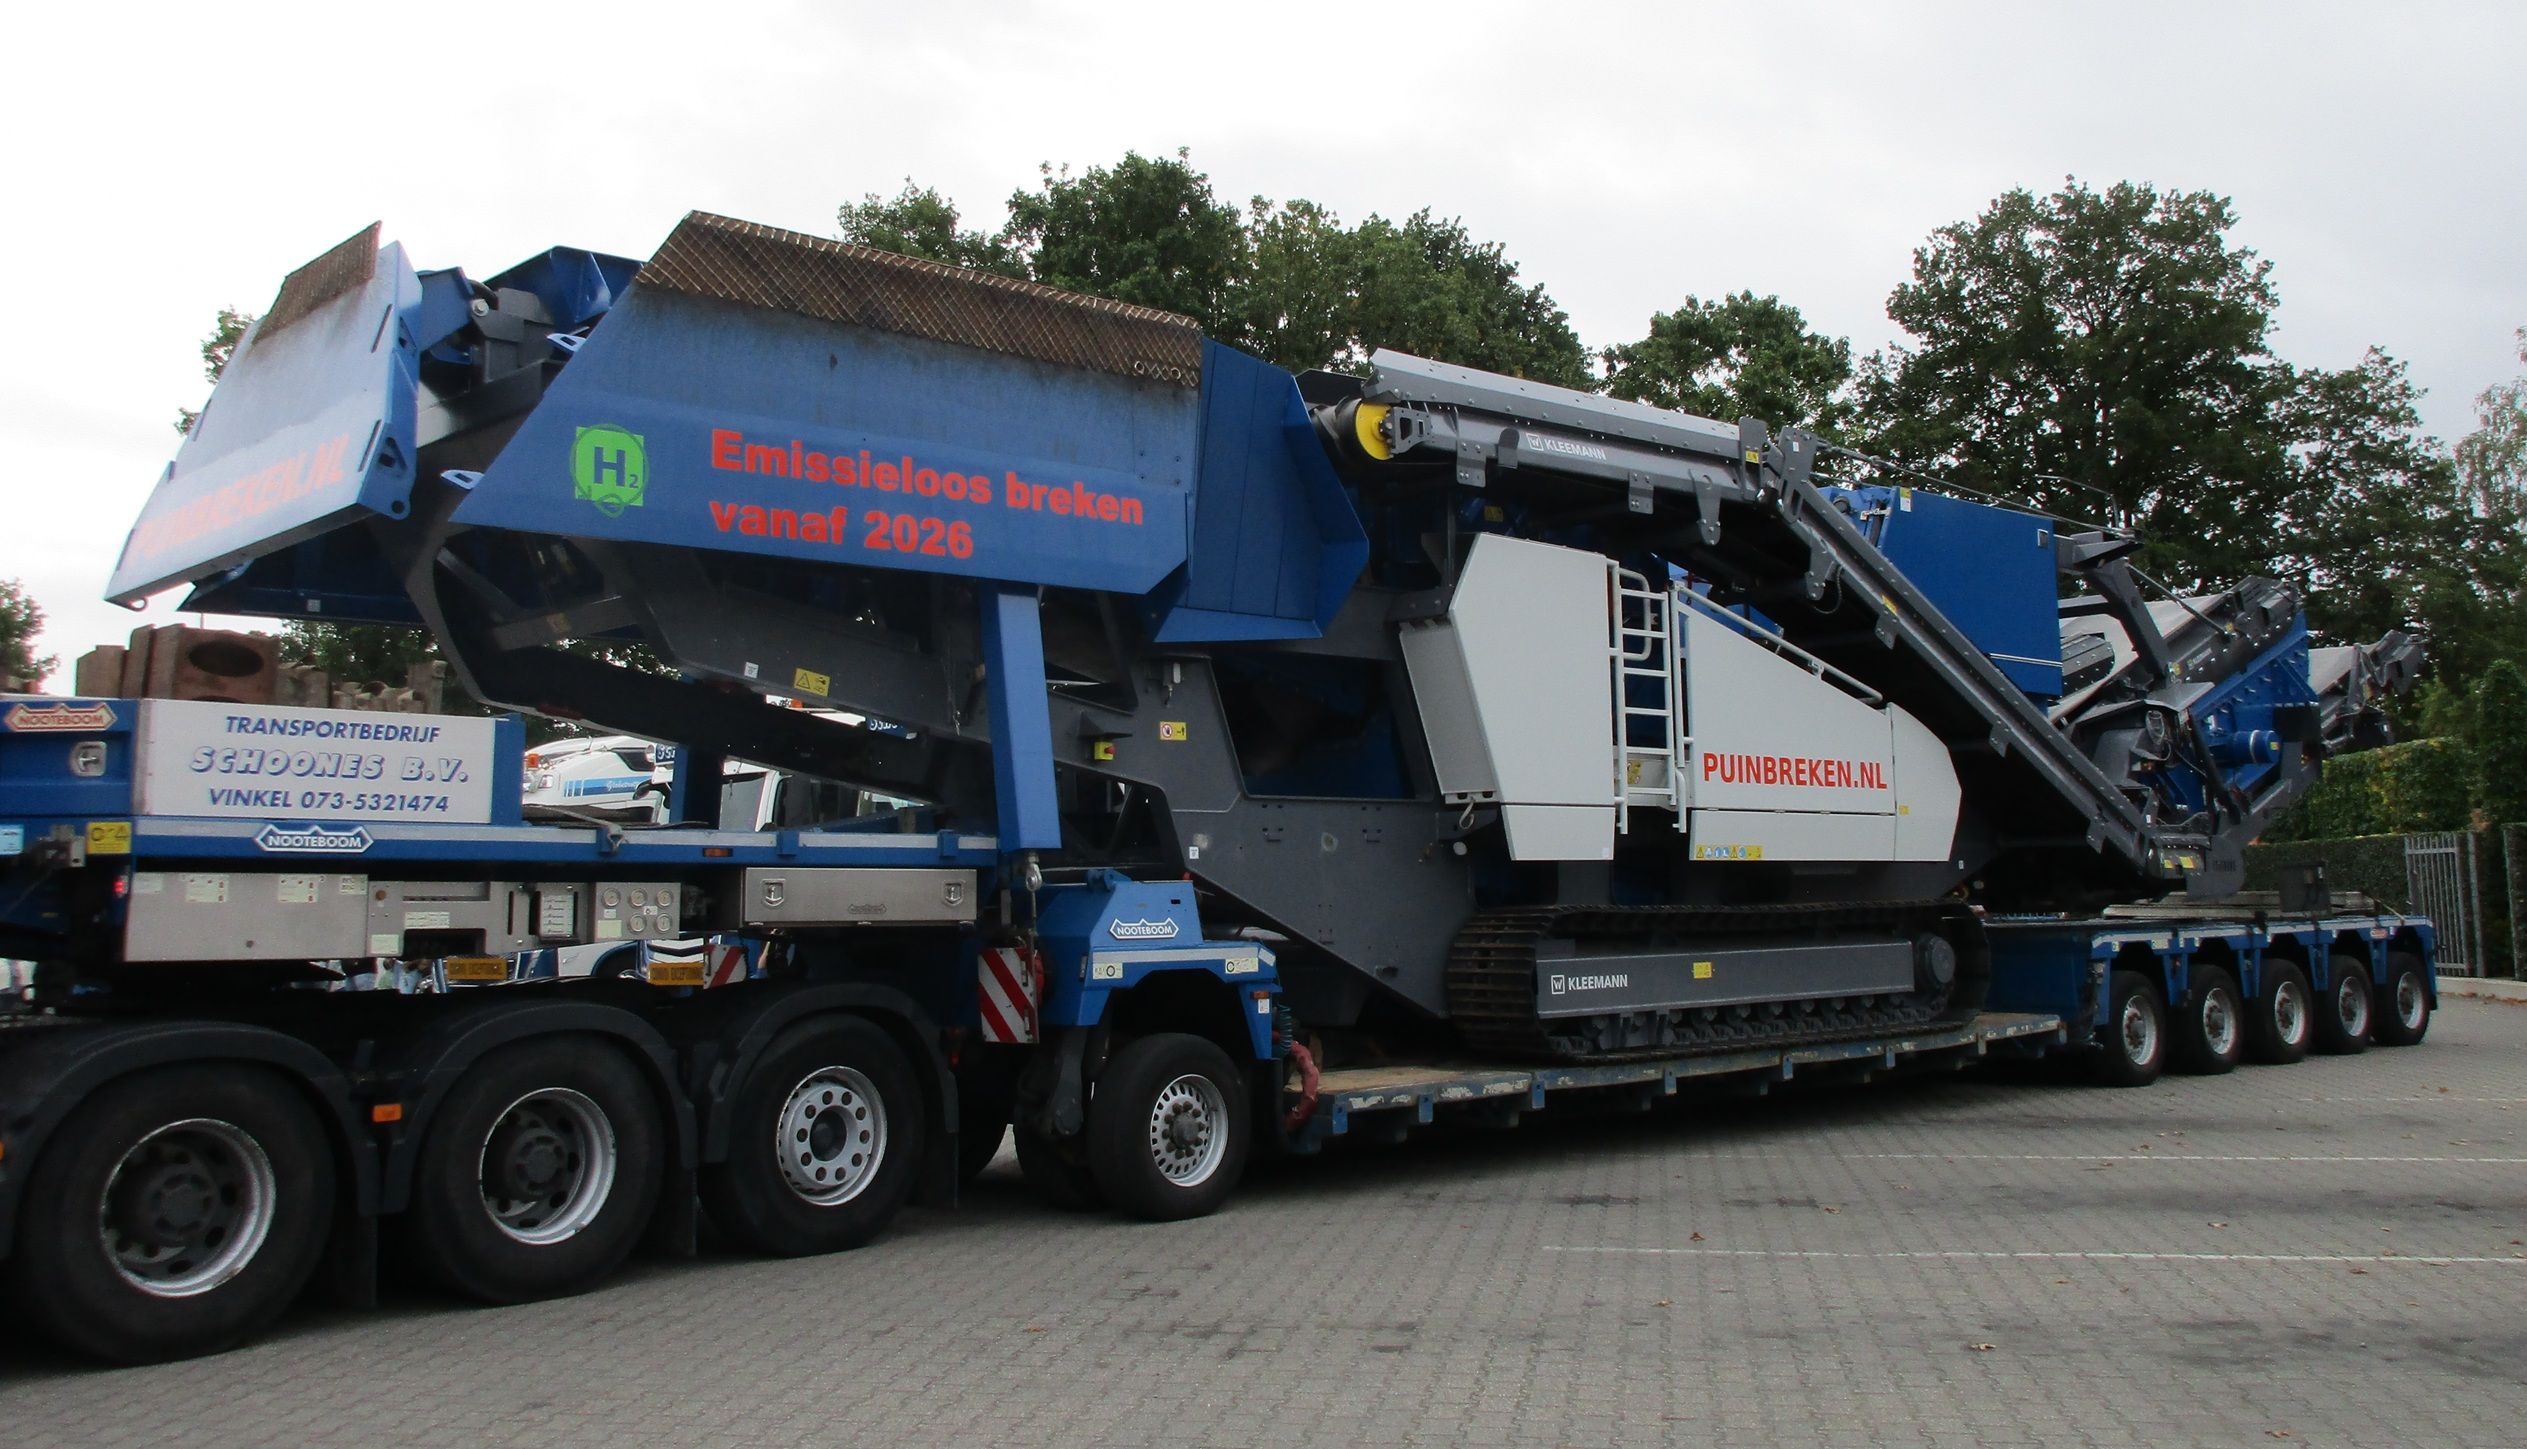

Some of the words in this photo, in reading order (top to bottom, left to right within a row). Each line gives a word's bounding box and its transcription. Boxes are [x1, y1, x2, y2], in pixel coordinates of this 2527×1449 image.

[1544, 438, 1607, 461] KLEEMANN
[711, 428, 992, 504] Emissieloos
[1006, 471, 1143, 525] breken
[709, 499, 848, 545] vanaf
[863, 510, 973, 559] 2026
[19, 714, 104, 726] NOOTEBOOM
[226, 715, 441, 743] TRANSPORTBEDRIJF
[189, 746, 386, 778] SCHOONES
[400, 756, 469, 783] B.V.
[1703, 752, 1888, 790] PUINBREKEN.NL
[208, 788, 293, 808] VINKEL
[301, 791, 450, 812] 073-5321474
[268, 835, 362, 848] NOOTEBOOM
[1116, 925, 1173, 936] NOOTEBOOM
[1568, 974, 1629, 991] KLEEMANN
